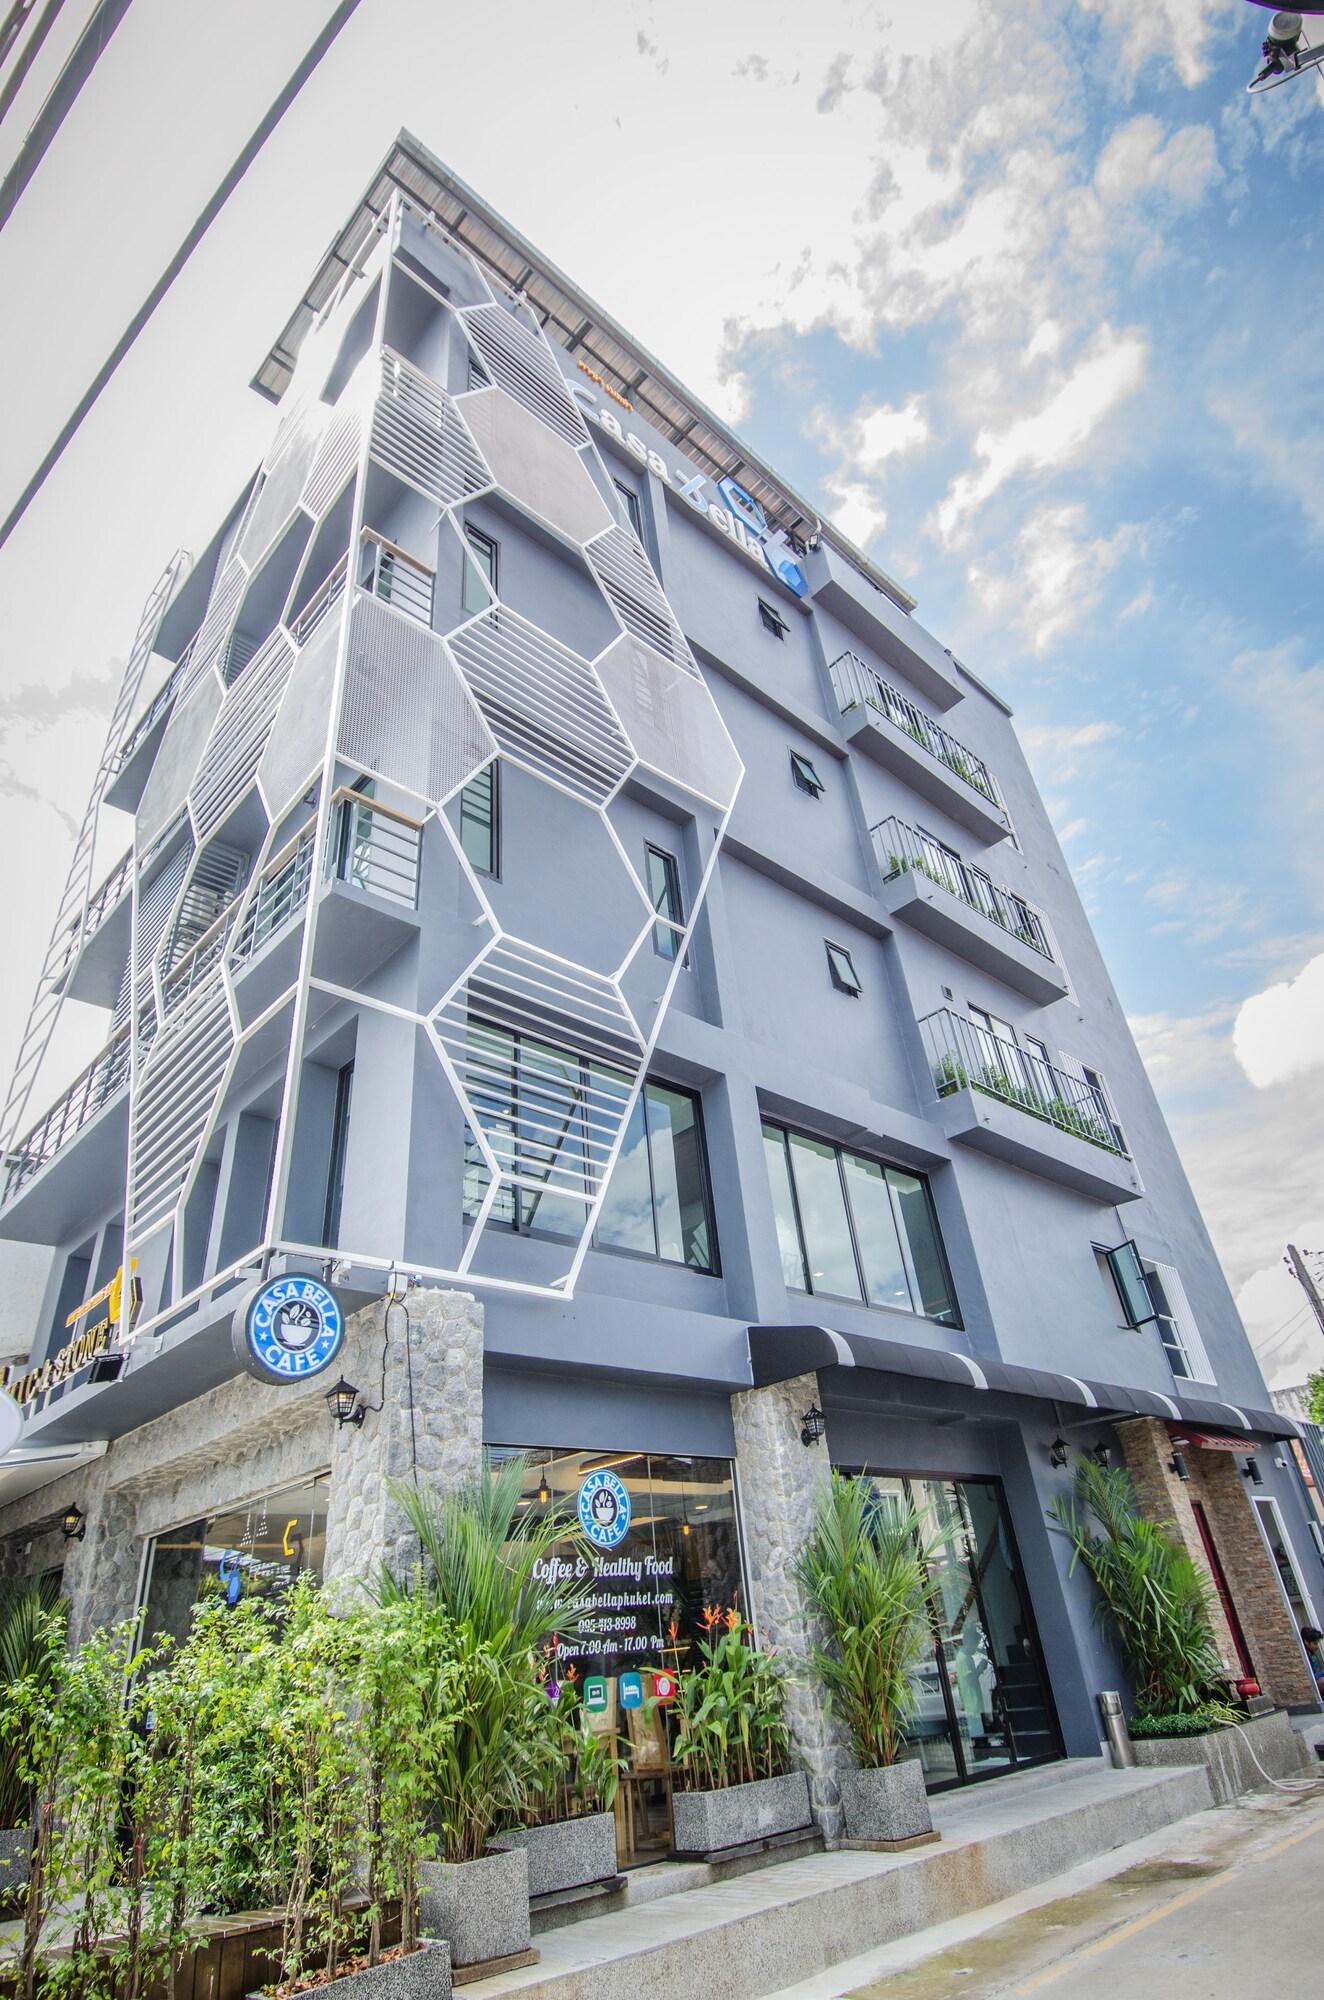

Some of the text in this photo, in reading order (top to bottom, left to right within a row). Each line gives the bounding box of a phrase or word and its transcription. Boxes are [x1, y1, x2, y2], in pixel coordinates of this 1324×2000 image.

[566, 378, 673, 486] Casa
[675, 469, 771, 570] bella
[254, 1282, 336, 1338] CASA BELLA
[264, 1347, 321, 1372] CAFE
[581, 1475, 627, 1514] CASA BELLA
[590, 1523, 622, 1542] CAFE
[532, 1554, 674, 1585] Coffee & Healthy Food
[557, 1643, 579, 1661] Open
[580, 1639, 602, 1656] 7.00
[602, 1638, 618, 1655] Am
[624, 1636, 647, 1652] 17.00
[650, 1635, 665, 1650] Pm
